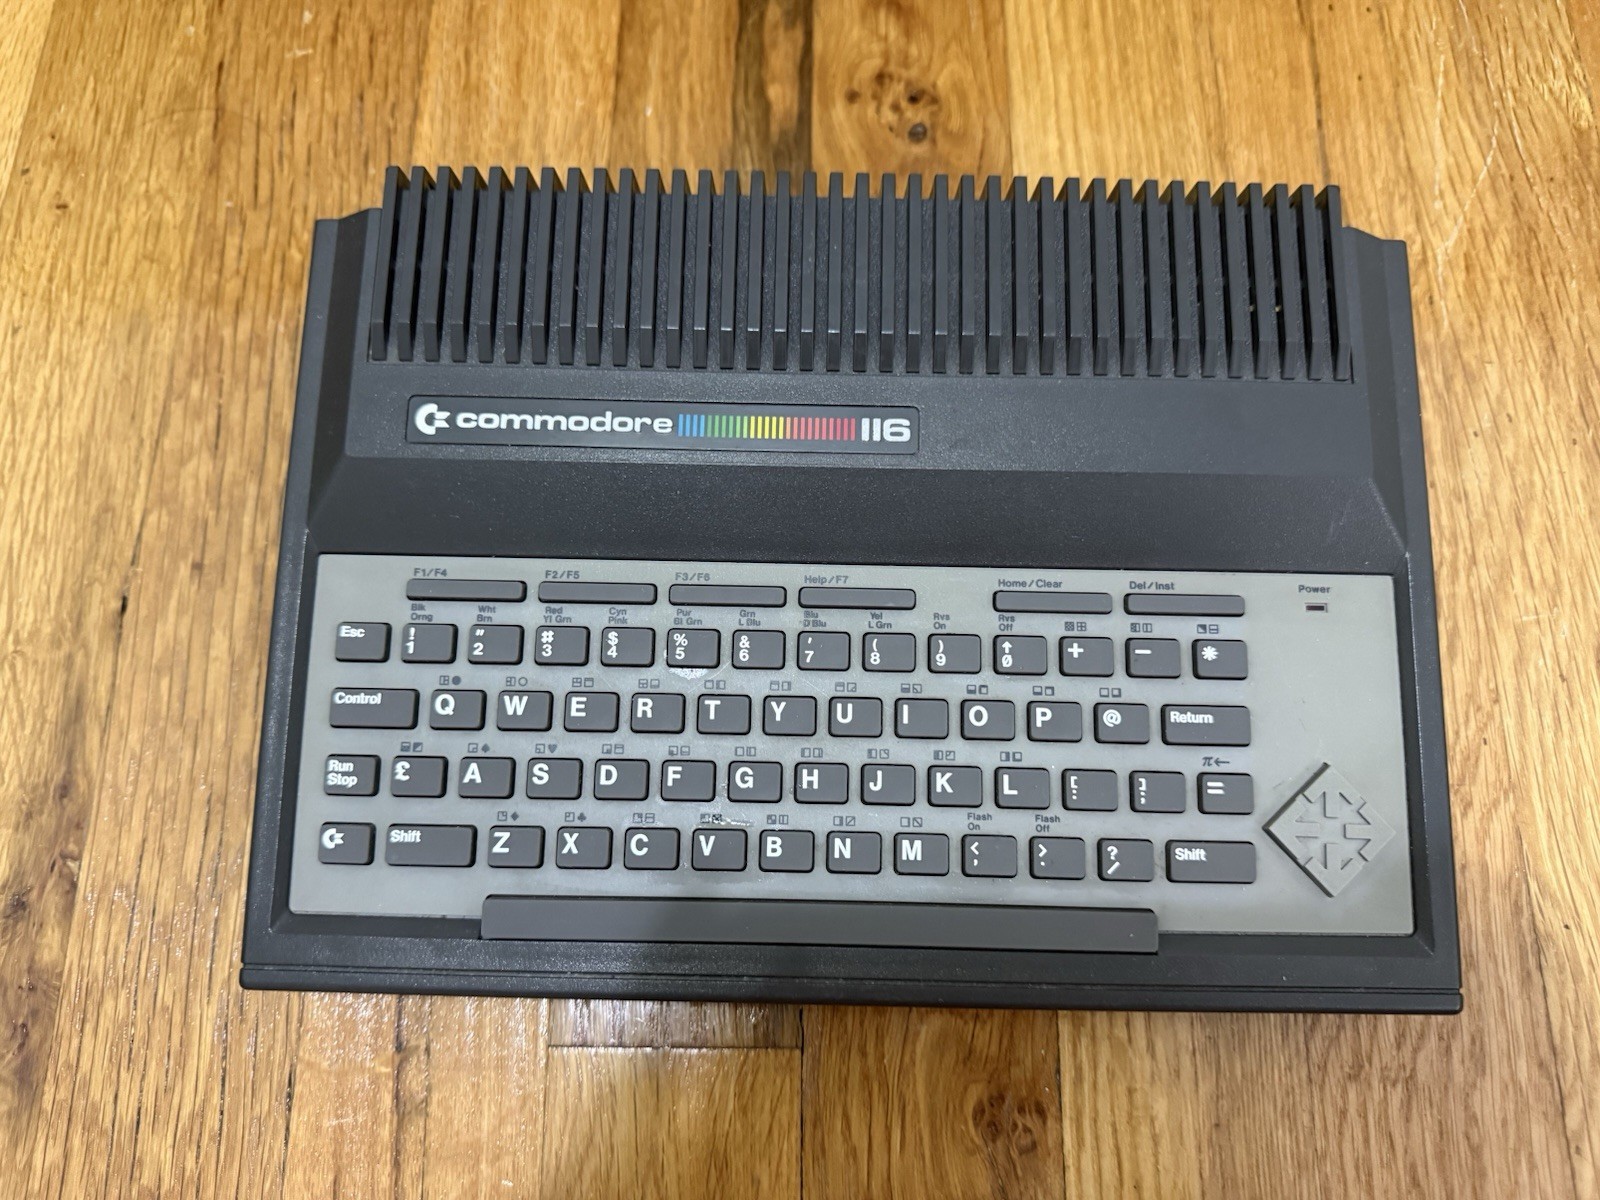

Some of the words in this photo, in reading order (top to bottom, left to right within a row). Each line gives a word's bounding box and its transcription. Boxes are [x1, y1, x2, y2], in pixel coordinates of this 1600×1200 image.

[456, 410, 673, 435] commodore
[861, 417, 912, 443] 116
[413, 568, 447, 578] F1/F4
[545, 570, 580, 580] F2/F5
[675, 572, 710, 581] F3/F6
[804, 575, 848, 585] Help/F7
[998, 579, 1062, 589] Home/Clear
[1129, 581, 1175, 591] Del/Inst
[1298, 585, 1330, 594] Power
[411, 603, 426, 612] Blk
[478, 605, 496, 613] Wht
[545, 606, 563, 615] Red
[608, 608, 627, 617] Cyn
[739, 610, 756, 618] Grn
[410, 612, 433, 622] Orng
[477, 614, 492, 622] Brn
[556, 615, 572, 624] Grn
[608, 616, 628, 624] Pink
[686, 618, 702, 626] Grn
[745, 618, 761, 627] Blu
[933, 613, 950, 621] Rvs
[998, 614, 1015, 623] Rvs
[812, 620, 827, 628] Blu
[874, 621, 892, 629] Grn
[998, 623, 1013, 632] Off
[340, 626, 365, 638] Esc
[406, 641, 414, 654] 1
[473, 643, 483, 656] 2
[542, 644, 552, 657] 3
[607, 646, 618, 658] 4
[675, 648, 685, 660] 5
[739, 649, 749, 661] 6
[805, 651, 814, 663] 7
[870, 652, 880, 665] 8
[936, 654, 946, 666] 9
[334, 692, 382, 705] Control
[435, 694, 455, 716] Q
[504, 696, 528, 716] W
[570, 697, 587, 717] E
[636, 698, 654, 718] R
[705, 700, 720, 720] T
[771, 702, 787, 722] Y
[836, 703, 853, 724] U
[969, 706, 988, 727] O
[1035, 708, 1052, 728] P
[1102, 709, 1122, 727] @
[1170, 711, 1214, 724] Return
[328, 760, 354, 772] Run
[395, 761, 410, 781] £
[463, 763, 482, 783] A
[532, 764, 549, 785] S
[600, 765, 618, 785] D
[667, 767, 682, 786] F
[735, 767, 754, 789] G
[802, 769, 819, 789] H
[327, 773, 358, 788] Stop
[869, 771, 882, 791] J
[936, 772, 953, 793] K
[1003, 774, 1018, 795] L
[967, 812, 992, 821] Flash
[1035, 815, 1060, 824] Flash
[1036, 824, 1050, 833] Off
[389, 830, 421, 843] Shift
[492, 832, 510, 853] Z
[562, 833, 579, 854] X
[630, 834, 649, 856] C
[699, 835, 715, 856] V
[766, 837, 783, 857] B
[834, 838, 851, 859] N
[902, 840, 922, 861] M
[1175, 848, 1207, 861] Shift
